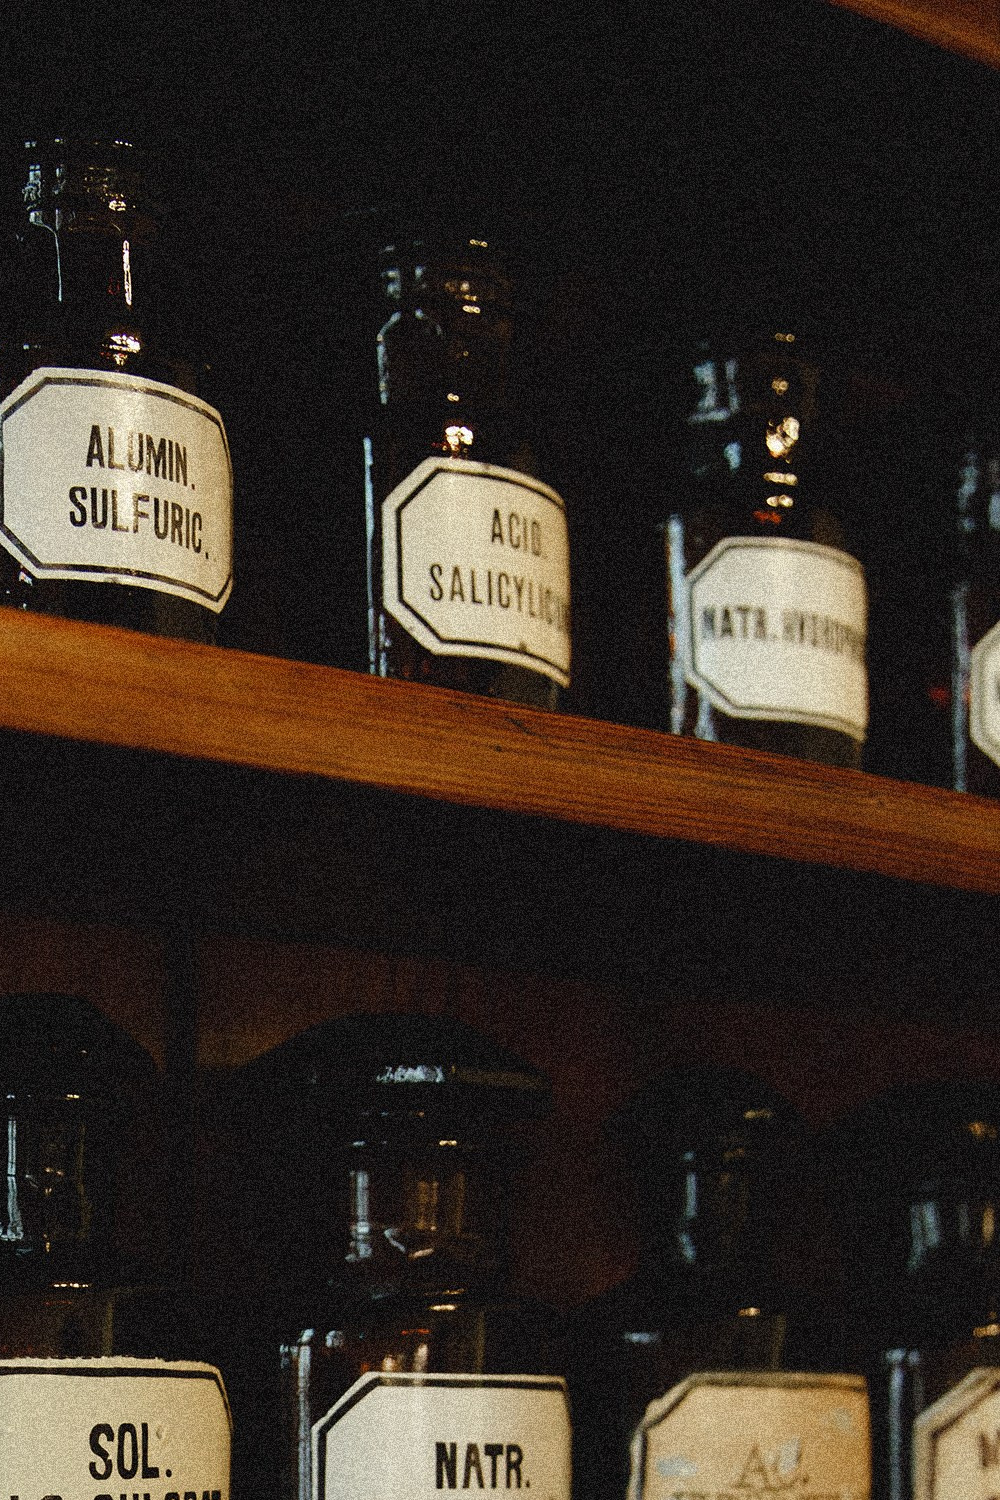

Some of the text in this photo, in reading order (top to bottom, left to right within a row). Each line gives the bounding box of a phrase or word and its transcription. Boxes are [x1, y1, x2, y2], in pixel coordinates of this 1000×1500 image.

[85, 424, 196, 490] ALUMIN.
[68, 486, 210, 559] SULFURIC.
[88, 1421, 173, 1481] SOL.
[435, 1441, 531, 1490] NATR.
